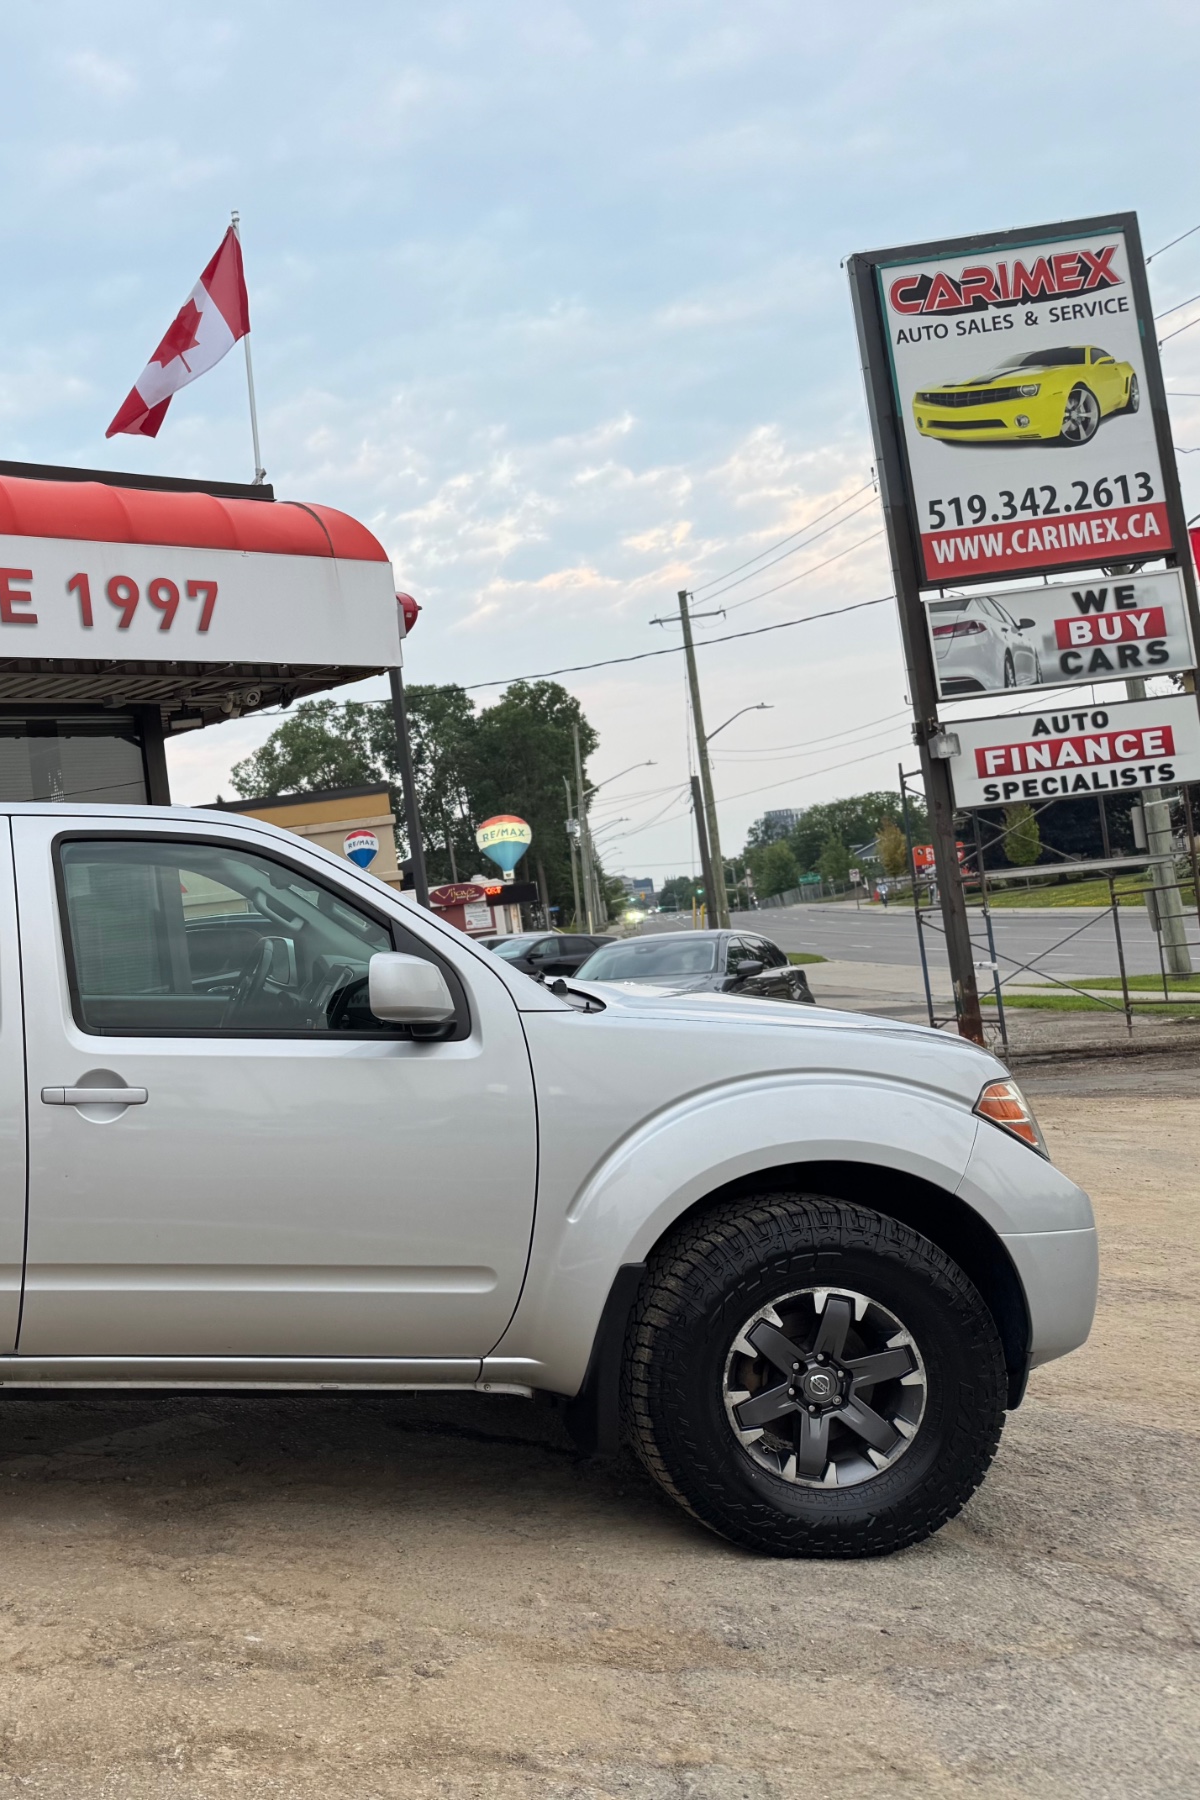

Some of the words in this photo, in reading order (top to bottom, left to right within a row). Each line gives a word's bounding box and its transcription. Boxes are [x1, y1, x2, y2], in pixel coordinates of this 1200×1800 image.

[889, 244, 1125, 316] CARIMEX
[896, 323, 949, 345] AUTO
[956, 313, 1014, 337] SALES
[1024, 311, 1039, 326] &
[1049, 296, 1129, 323] SERVICE
[928, 471, 1154, 530] 519.342.2613
[931, 511, 1160, 564] WWW.CARIMEX.CA
[67, 572, 218, 632] 1997
[1072, 584, 1138, 615] WE
[1068, 612, 1151, 645] BUY
[1059, 640, 1170, 675] CARS
[1032, 711, 1109, 737] AUTO
[984, 730, 1166, 775] FINANCE
[983, 763, 1176, 802] SPECIALISTS
[347, 839, 375, 849] RE/MAX
[482, 827, 525, 842] RE/MAX
